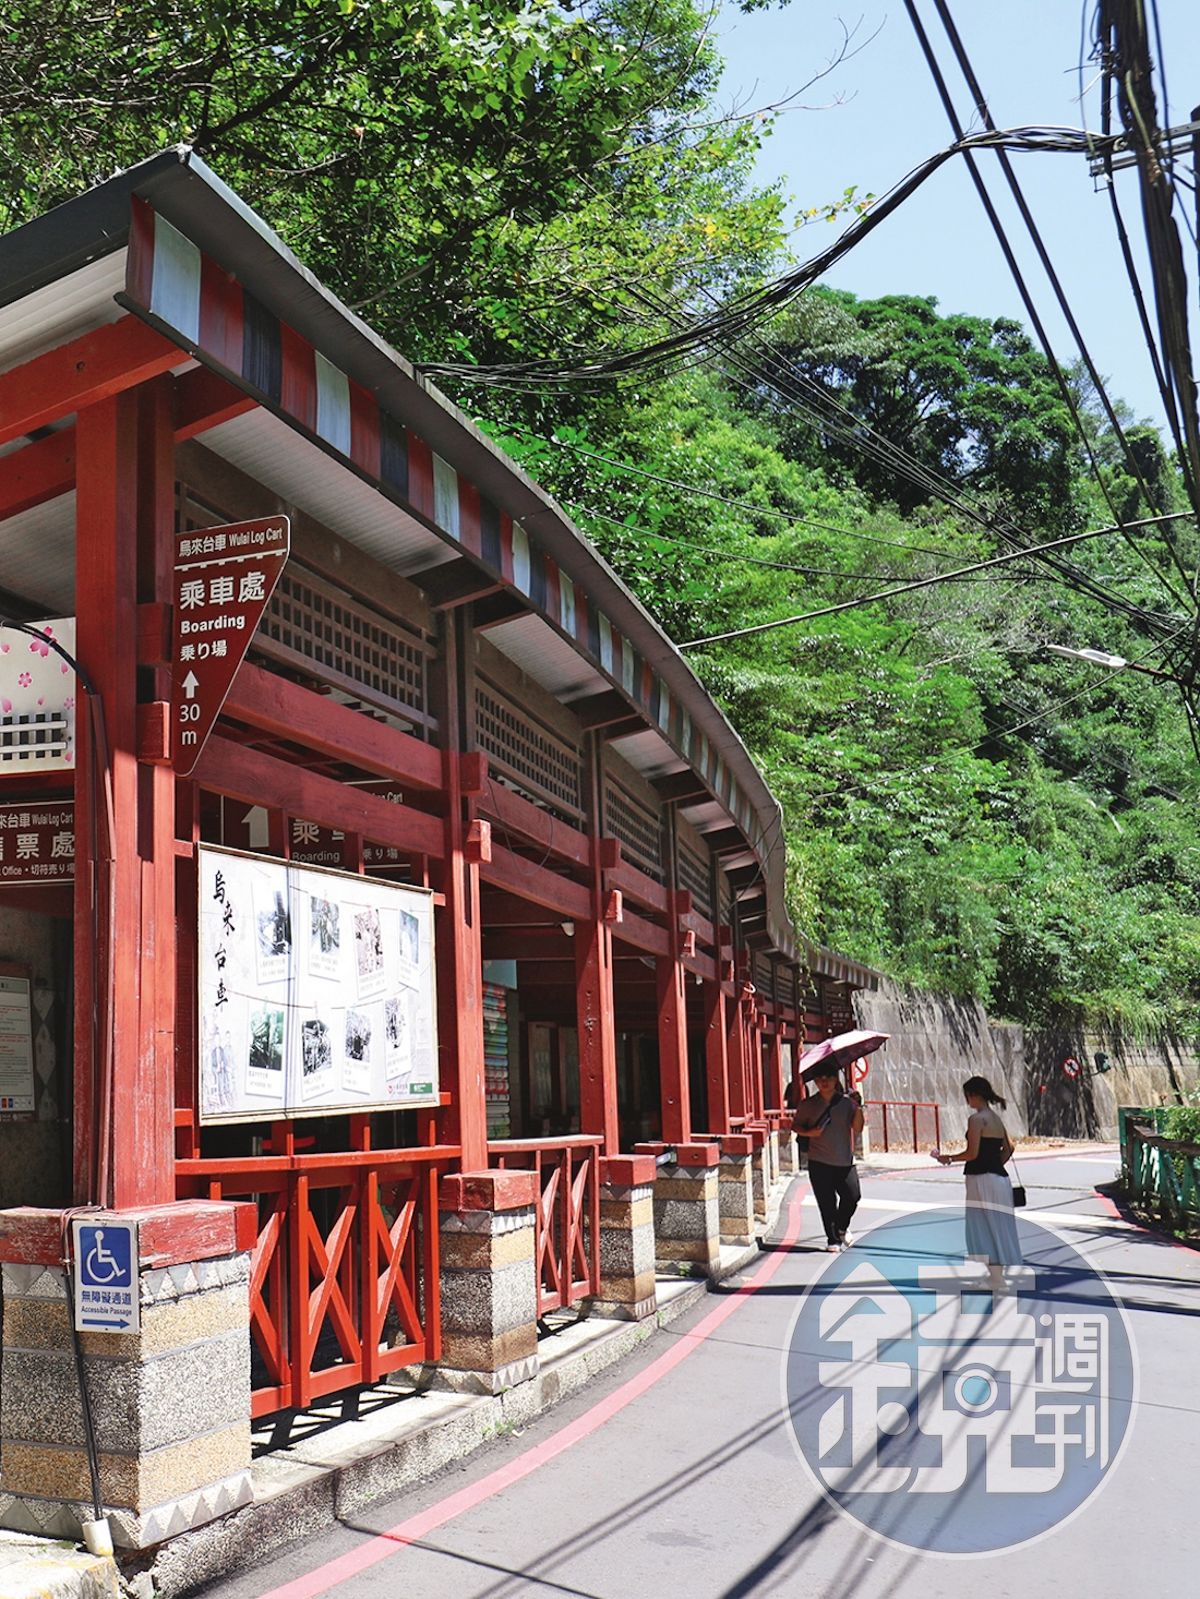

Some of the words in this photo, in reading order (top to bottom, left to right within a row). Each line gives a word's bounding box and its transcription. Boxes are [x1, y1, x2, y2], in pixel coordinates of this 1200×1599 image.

[179, 534, 226, 557] 烏來台車
[229, 532, 250, 547] Wulai
[251, 531, 265, 545] Log
[266, 527, 283, 541] Cart
[180, 571, 266, 610] 乘車處
[181, 614, 246, 635] Boarding
[179, 703, 201, 722] 30
[181, 730, 197, 745] m
[48, 812, 59, 827] Log
[292, 850, 341, 863] Boarding
[2, 865, 22, 876] Office
[81, 1305, 109, 1314] Accessible
[109, 1307, 132, 1316] Passage
